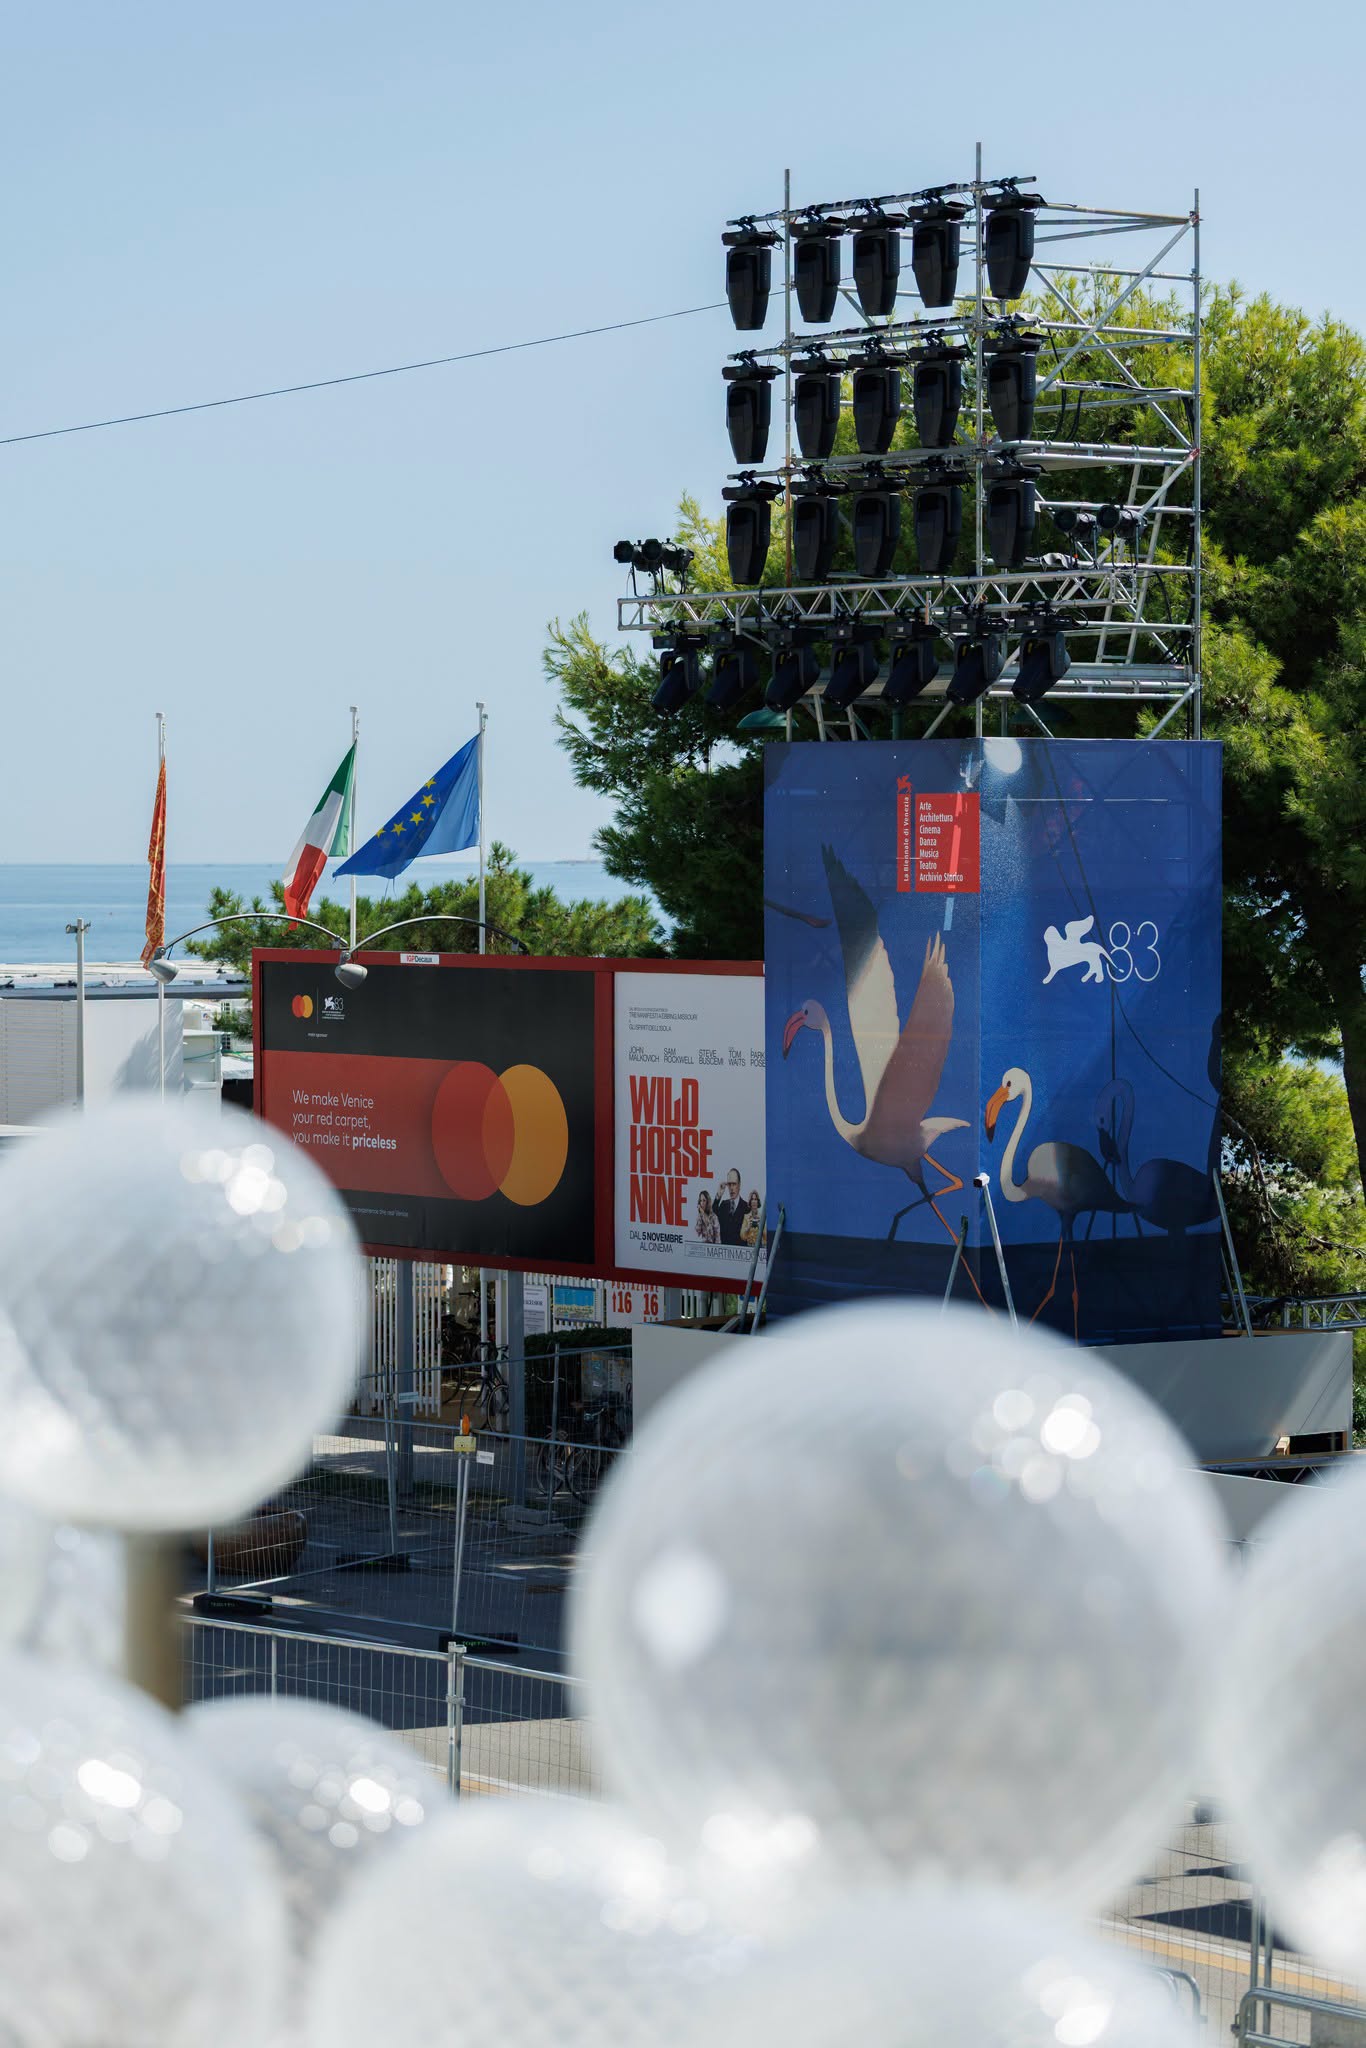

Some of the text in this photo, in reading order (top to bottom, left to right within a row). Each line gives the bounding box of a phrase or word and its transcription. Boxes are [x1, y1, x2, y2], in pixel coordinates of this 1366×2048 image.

[920, 802, 932, 810] Arte
[920, 813, 953, 822] Architettura
[920, 825, 940, 834] Cinema
[920, 837, 936, 846] Danza
[920, 849, 938, 858] Musica
[920, 861, 937, 870] Teatro
[920, 872, 964, 882] Archivio Storico
[1106, 922, 1160, 982] 83
[630, 1046, 644, 1054] JOHN
[664, 1048, 676, 1056] SAM
[699, 1049, 716, 1058] STEVE
[728, 1050, 742, 1058] TOM
[629, 1054, 660, 1062] MALKOVICH
[664, 1056, 694, 1064] ROCKWELL
[699, 1057, 724, 1066] BUSCEMI
[729, 1058, 746, 1066] WAITS
[292, 1089, 374, 1109] We make Venice
[630, 1075, 699, 1128] WILD
[293, 1112, 371, 1130] your red carpet,
[293, 1130, 396, 1150] you make it priceless
[630, 1124, 714, 1179] HORSE
[630, 1174, 688, 1227] NINE
[630, 1230, 683, 1243] DAL 5 NOVEMBRE
[640, 1242, 673, 1253] AL CINEMA
[706, 1248, 734, 1259] MARTIN
[618, 1291, 659, 1316] 16 16
